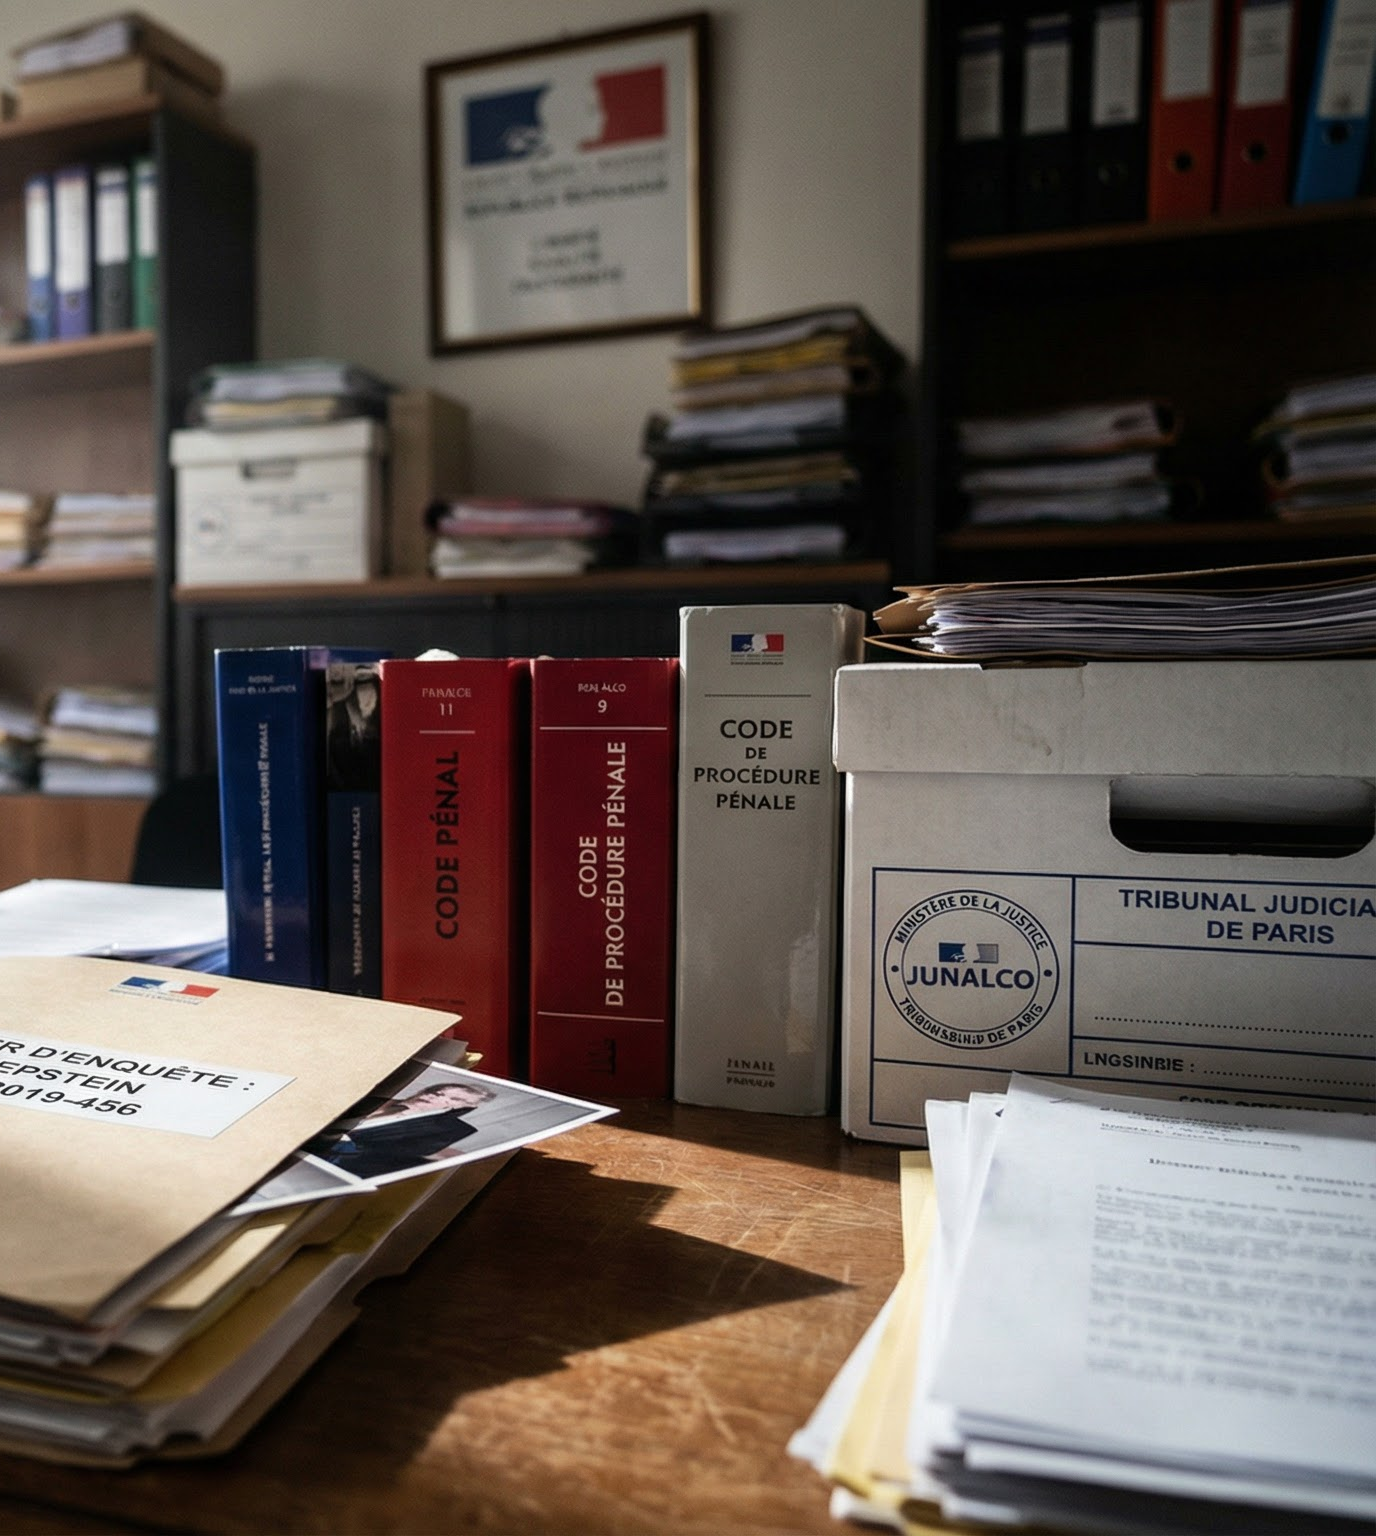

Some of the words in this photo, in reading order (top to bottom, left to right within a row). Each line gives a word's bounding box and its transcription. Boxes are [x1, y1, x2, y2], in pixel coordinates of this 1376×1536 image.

[439, 703, 453, 716] 11
[597, 699, 608, 714] 9
[720, 719, 793, 739] CODE
[745, 747, 767, 760] DE
[602, 742, 626, 828] PÉNALE
[694, 765, 821, 785] PROCÉDURE
[429, 751, 459, 846] PÉNAL
[716, 791, 796, 811] PÉNALE
[579, 836, 598, 898] CODE
[435, 857, 459, 940] CODE
[601, 835, 625, 969] PROCÉDURE
[1119, 889, 1256, 913] TRIBUNAL
[1264, 894, 1376, 918] JUDICIA
[960, 895, 979, 907] DE
[983, 898, 1000, 912] LA
[1000, 906, 1049, 951] JUSTICE
[1207, 920, 1243, 940] DE
[1252, 922, 1335, 945] PARIS
[906, 966, 1035, 989] JUNALCO
[605, 978, 624, 1007] DE
[987, 1029, 1007, 1043] DE
[28, 1046, 239, 1089] D'ENQUÊTE
